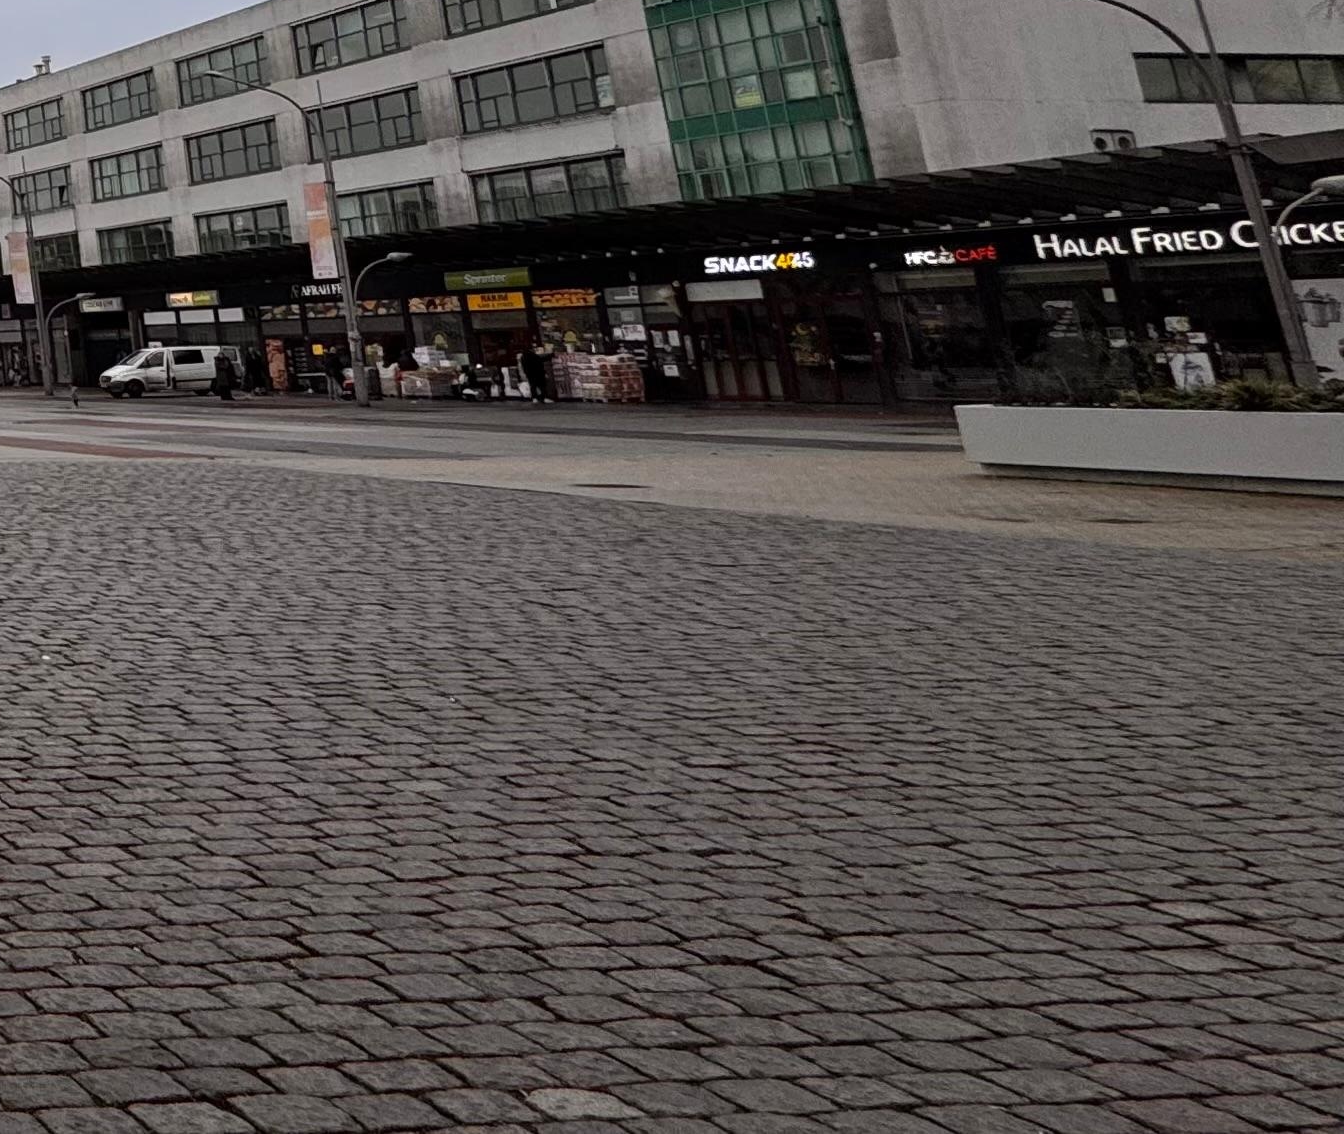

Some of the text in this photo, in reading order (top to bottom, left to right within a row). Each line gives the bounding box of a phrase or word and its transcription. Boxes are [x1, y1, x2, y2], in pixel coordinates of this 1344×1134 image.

[1033, 233, 1128, 259] HALAL
[1130, 227, 1223, 254] FRIED
[904, 250, 938, 266] HFC
[463, 273, 507, 286] Sprinter
